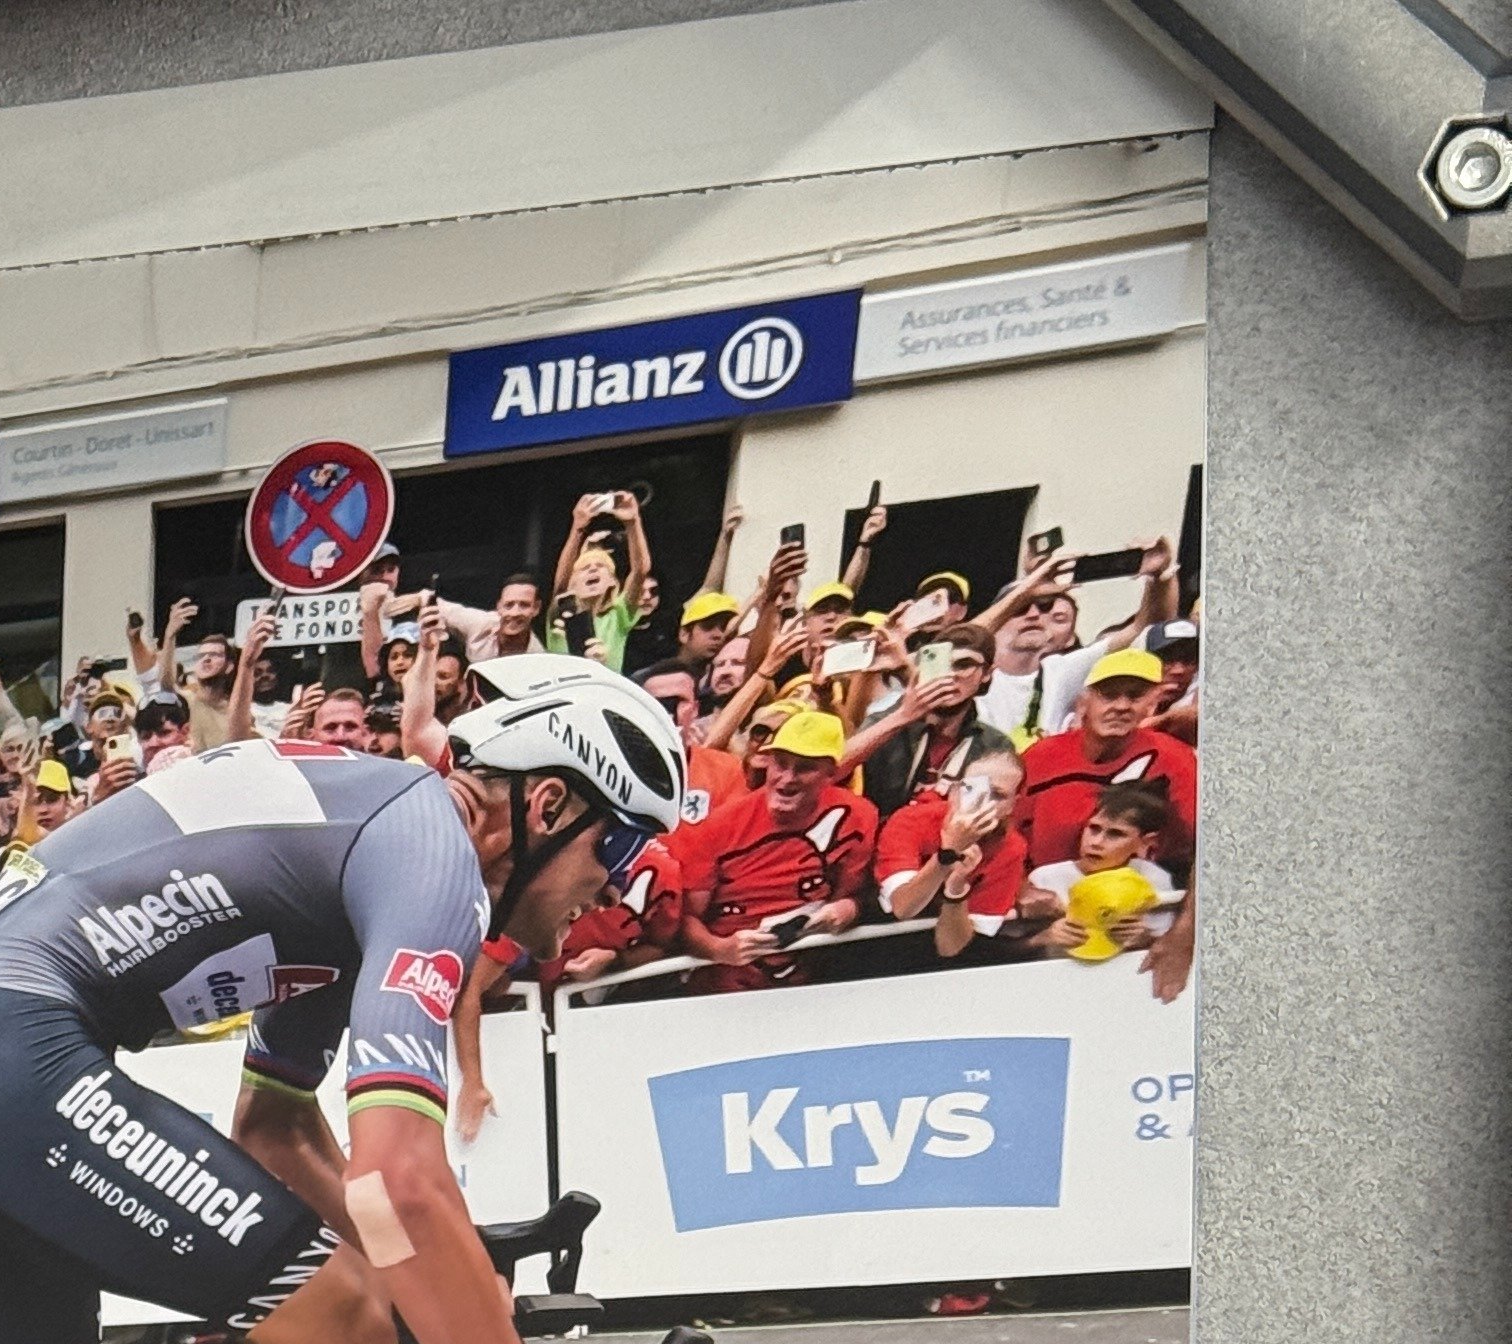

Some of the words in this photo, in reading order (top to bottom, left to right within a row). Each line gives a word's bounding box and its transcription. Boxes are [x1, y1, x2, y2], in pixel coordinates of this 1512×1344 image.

[491, 348, 705, 421] Allianz
[548, 711, 633, 806] CANYON
[78, 869, 235, 966] Alpecin
[150, 906, 243, 952] BOOSTER
[55, 1070, 264, 1247] deceuninck
[719, 1086, 996, 1187] Krys
[68, 1159, 170, 1238] WINDOWS
